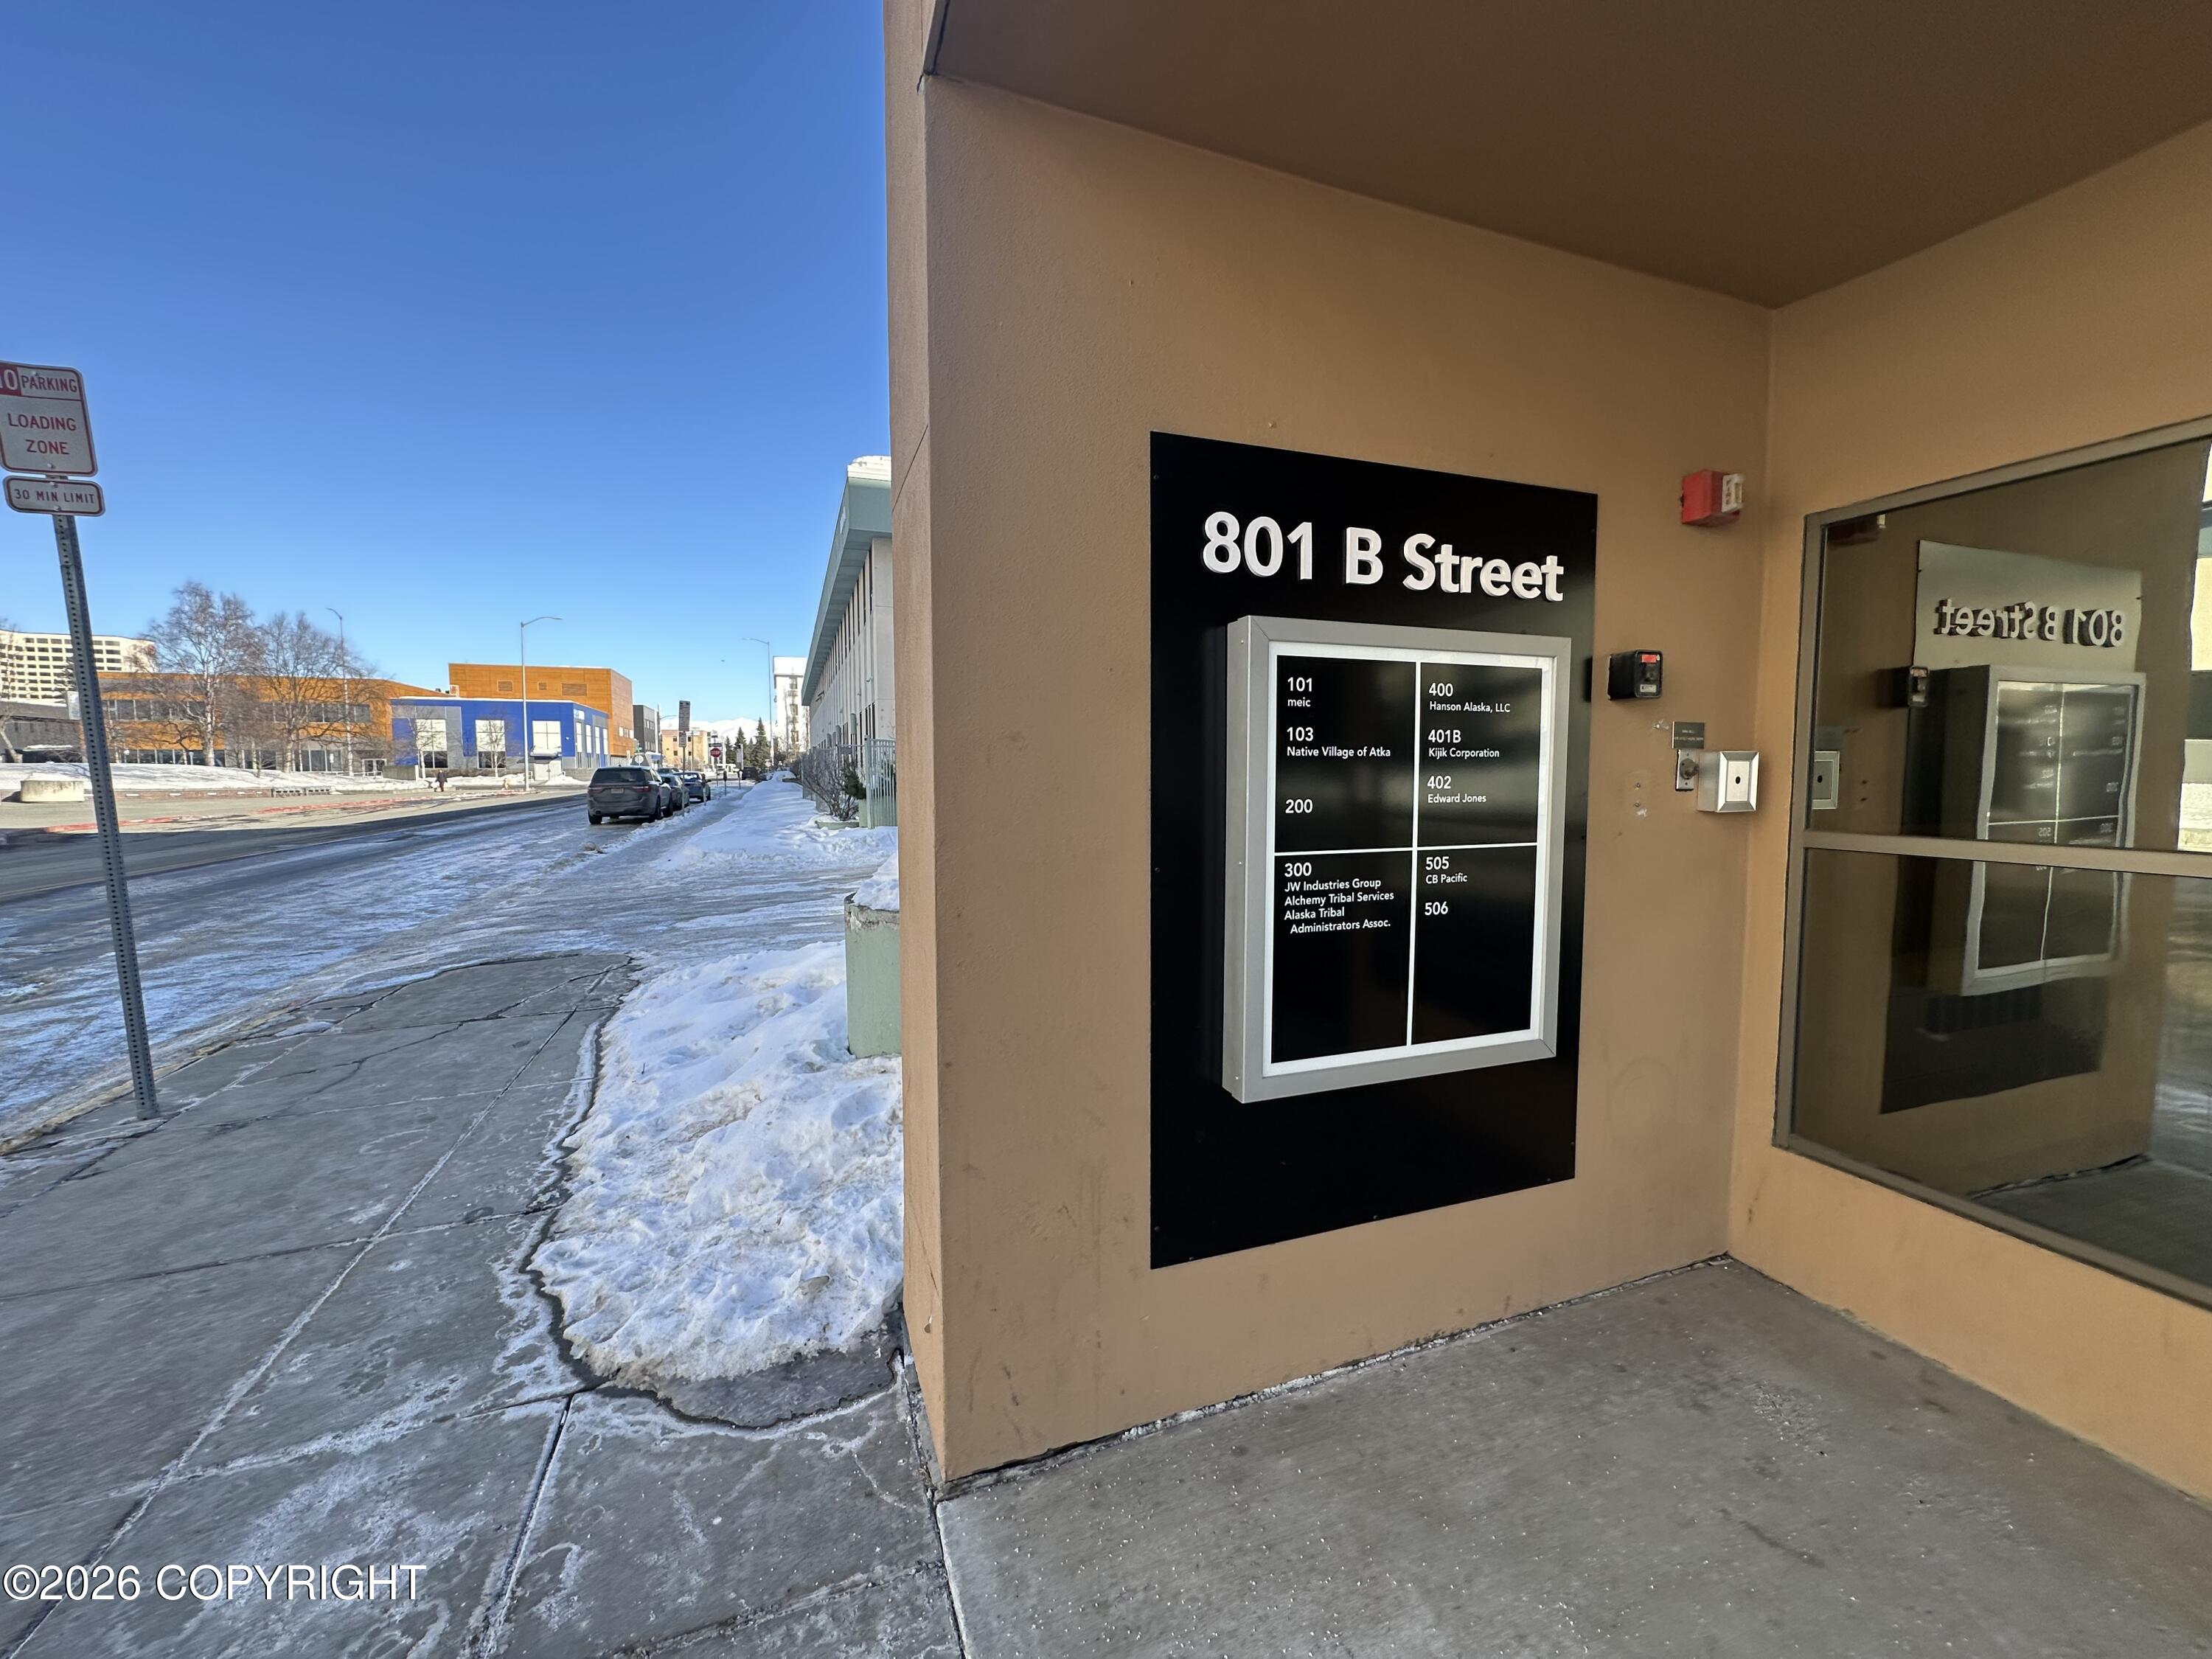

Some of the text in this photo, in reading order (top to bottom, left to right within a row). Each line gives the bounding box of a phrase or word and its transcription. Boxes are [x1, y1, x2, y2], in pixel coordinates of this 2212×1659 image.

[0, 369, 77, 392] O PARKING
[7, 413, 76, 431] LOADING
[25, 439, 70, 454] ZONE
[15, 489, 95, 504] 30 MIN LIMIT
[1203, 512, 1564, 602] 801 B Street
[1287, 677, 1312, 692] 101
[1428, 683, 1453, 697] 400
[1287, 697, 1311, 707] meic
[1430, 701, 1511, 713] Hanson Alaska, LLC
[1287, 726, 1314, 741] 103
[1427, 729, 1461, 743] 401B
[1287, 746, 1391, 759] Native Village of Atka
[1428, 748, 1500, 759] Kijik Corporation
[1427, 776, 1452, 789] 402
[1427, 793, 1486, 804] Edward Jones
[1285, 799, 1313, 813] 200
[1284, 862, 1312, 877] 300
[1425, 856, 1450, 870] 505
[1284, 878, 1381, 892] JW Industries Group
[1425, 873, 1468, 884] CB Pacific
[1284, 891, 1394, 906] Alchemy Tribal Services
[1284, 907, 1345, 920] Alaska Tribal
[1425, 902, 1449, 916] 506
[1290, 919, 1391, 934] Administrators Assoc.
